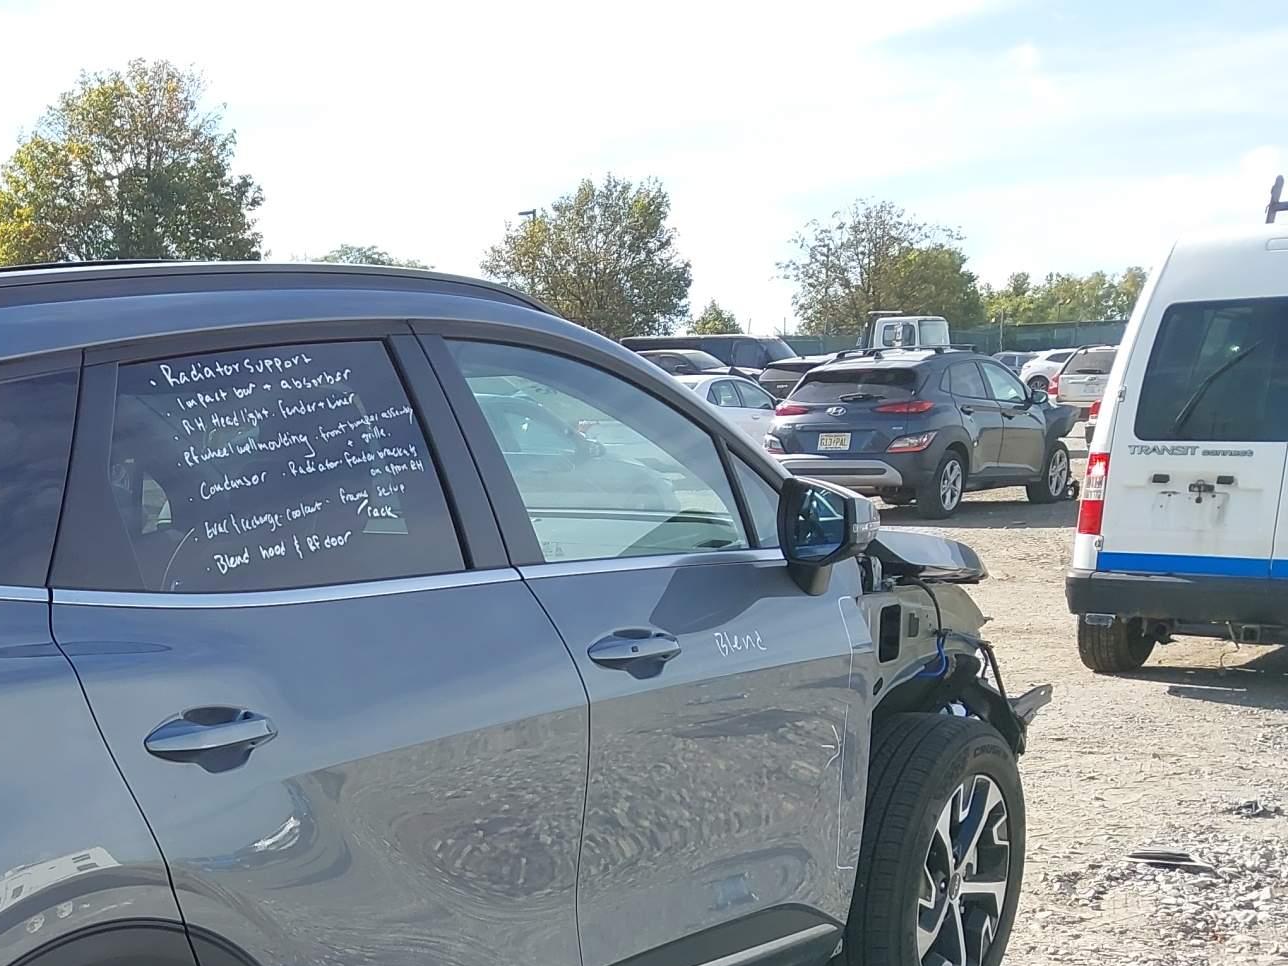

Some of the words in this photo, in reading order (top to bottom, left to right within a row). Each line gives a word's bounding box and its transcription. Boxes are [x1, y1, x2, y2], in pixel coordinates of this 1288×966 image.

[159, 362, 240, 387] Radiator
[176, 389, 227, 411] Impact
[280, 369, 352, 390] absorber
[1128, 444, 1200, 456] TRANSIT
[1201, 449, 1254, 457] connect
[213, 546, 250, 575] Blend
[258, 540, 287, 560] hood
[323, 531, 352, 548] door
